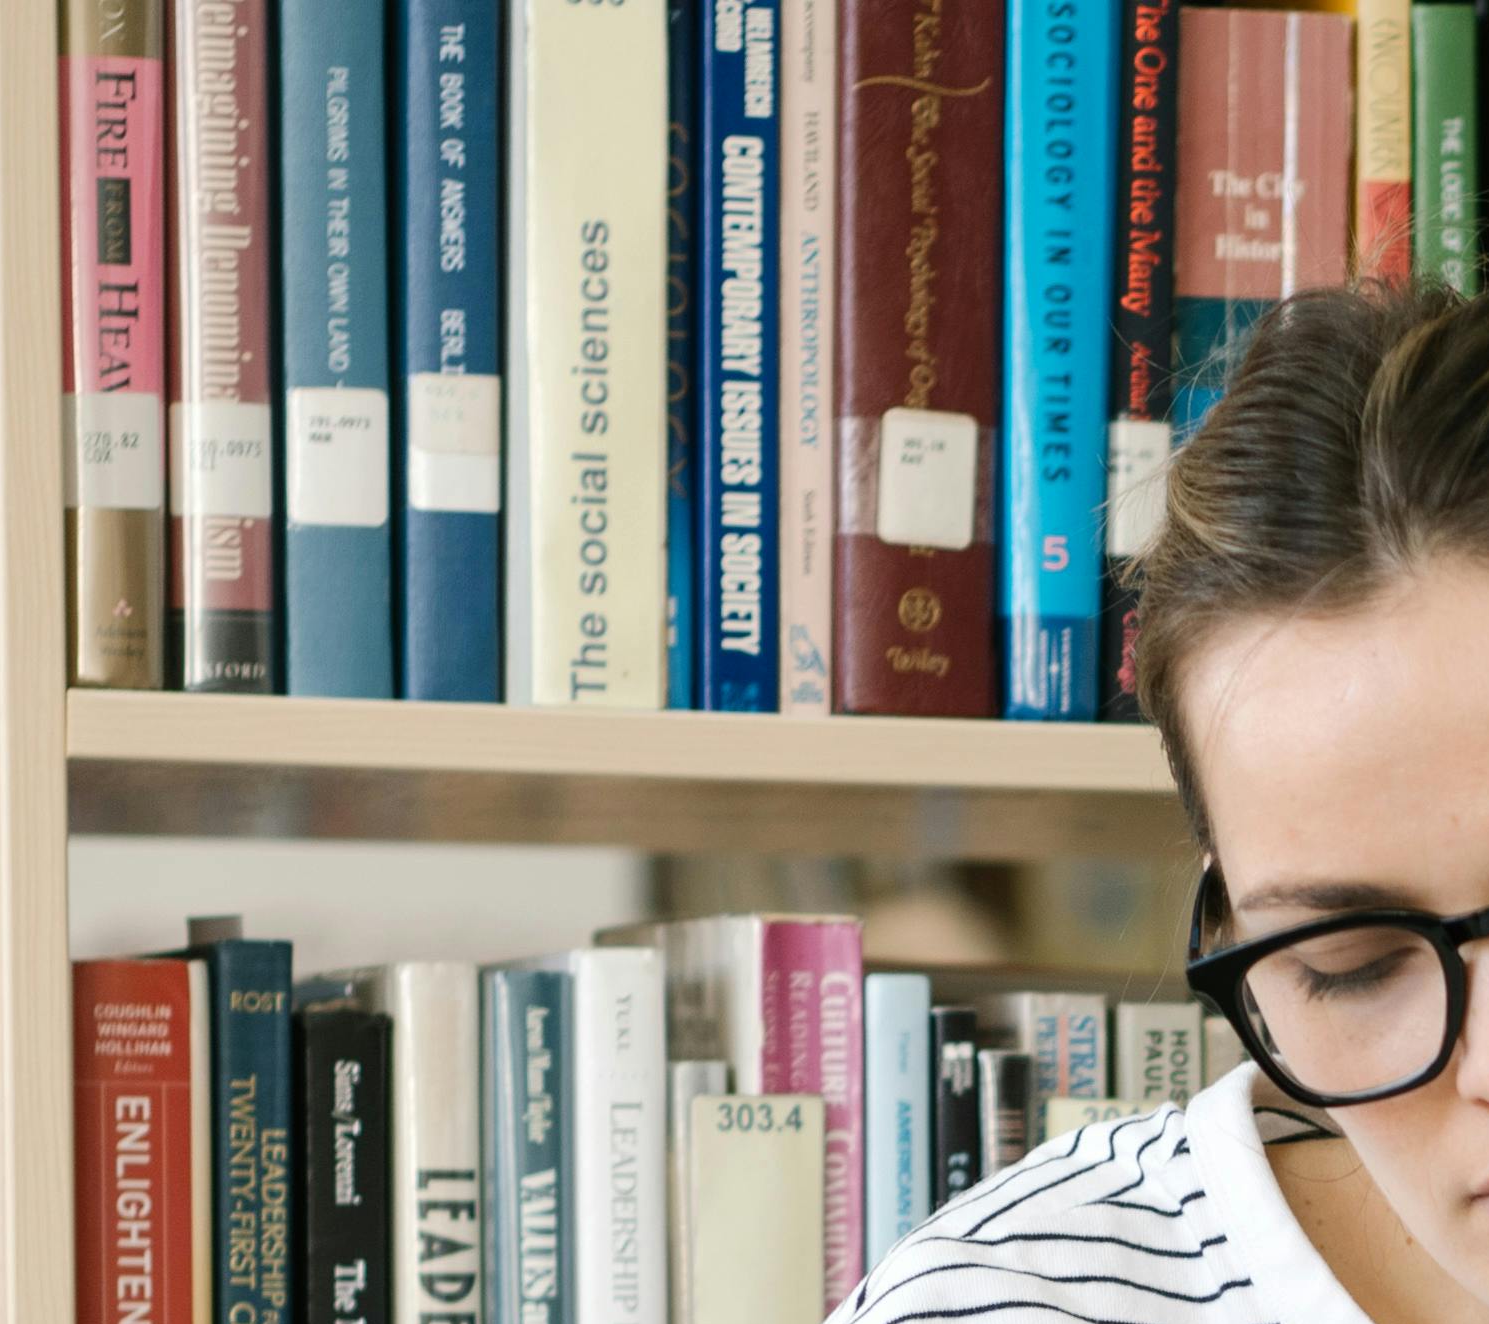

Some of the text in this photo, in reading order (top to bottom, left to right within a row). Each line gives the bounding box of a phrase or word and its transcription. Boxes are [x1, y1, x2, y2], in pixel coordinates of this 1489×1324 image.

[96, 70, 136, 169] FIRE
[439, 23, 466, 273] THE BOOK OF ANSWERS
[1441, 116, 1464, 155] THE
[326, 65, 351, 374] PILGRIMS THEIR OWN LAND
[1120, 46, 1169, 318] One and the Many
[1208, 170, 1252, 200] The
[1043, 2, 1075, 484] SOCIOLOGY IN OUR TIMES
[720, 135, 764, 656] CONTEMPORARY ISSUES IN SOCIETY
[799, 231, 821, 449] ANTHROPOLOGY
[571, 220, 609, 699] The social sciences
[1042, 535, 1069, 571] 5
[94, 1004, 171, 1020] COUGHLIN
[94, 1040, 171, 1057] HOLLIHAN
[97, 1022, 168, 1038] WINGARD
[230, 991, 287, 1014] ROST
[819, 970, 855, 1109] CULTURE
[717, 1104, 804, 1134] 303.4
[1144, 1029, 1167, 1099] PAUL
[229, 1074, 257, 1292] TWENTY-FIRST
[609, 1100, 643, 1314] LEADERSHIP
[895, 1099, 913, 1210] AMERICAN
[260, 1128, 288, 1307] LEADERSHIP
[520, 1168, 558, 1299] VALUES
[334, 1258, 367, 1313] The
